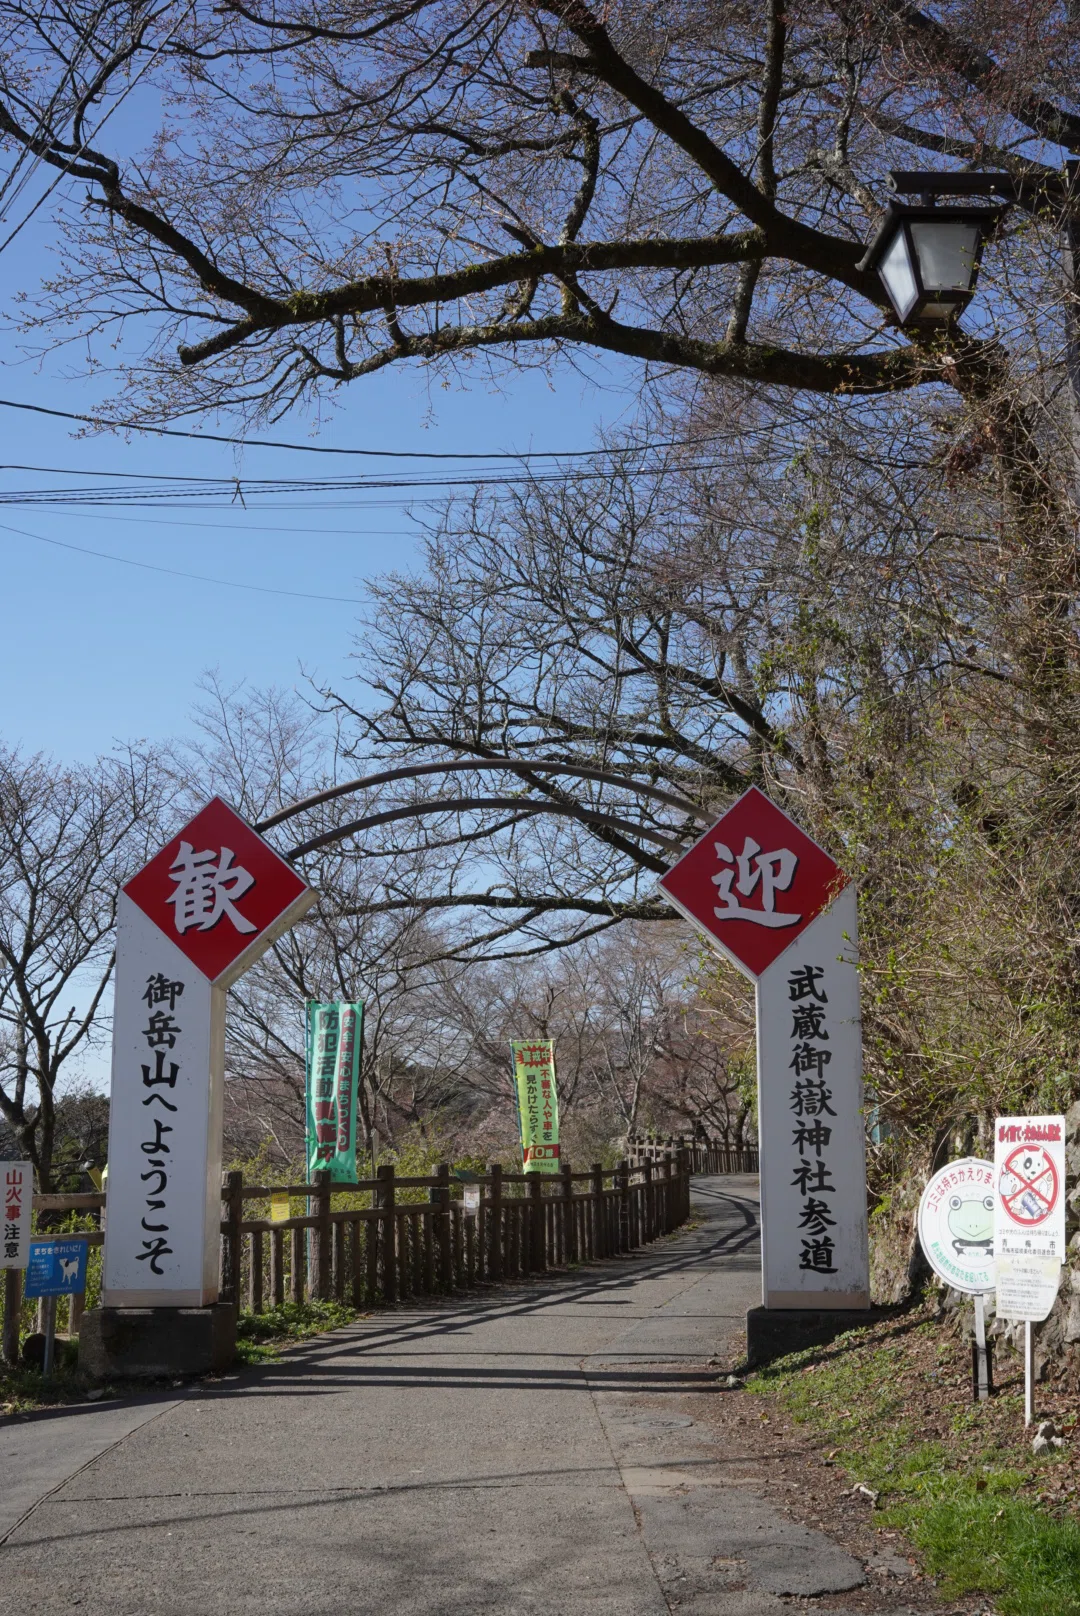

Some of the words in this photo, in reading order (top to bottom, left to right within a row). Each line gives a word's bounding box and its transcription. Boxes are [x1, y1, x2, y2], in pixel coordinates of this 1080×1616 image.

[165, 840, 258, 935] 歓
[711, 836, 803, 928] 迎
[135, 972, 185, 1275] 御岳山へようこそ
[526, 1075, 539, 1144] 見かけたらすぐ
[540, 1069, 553, 1141] 不審な人や車を
[787, 965, 838, 1275] 武蔵御嶽神社参道
[4, 1169, 23, 1259] 山火事注意
